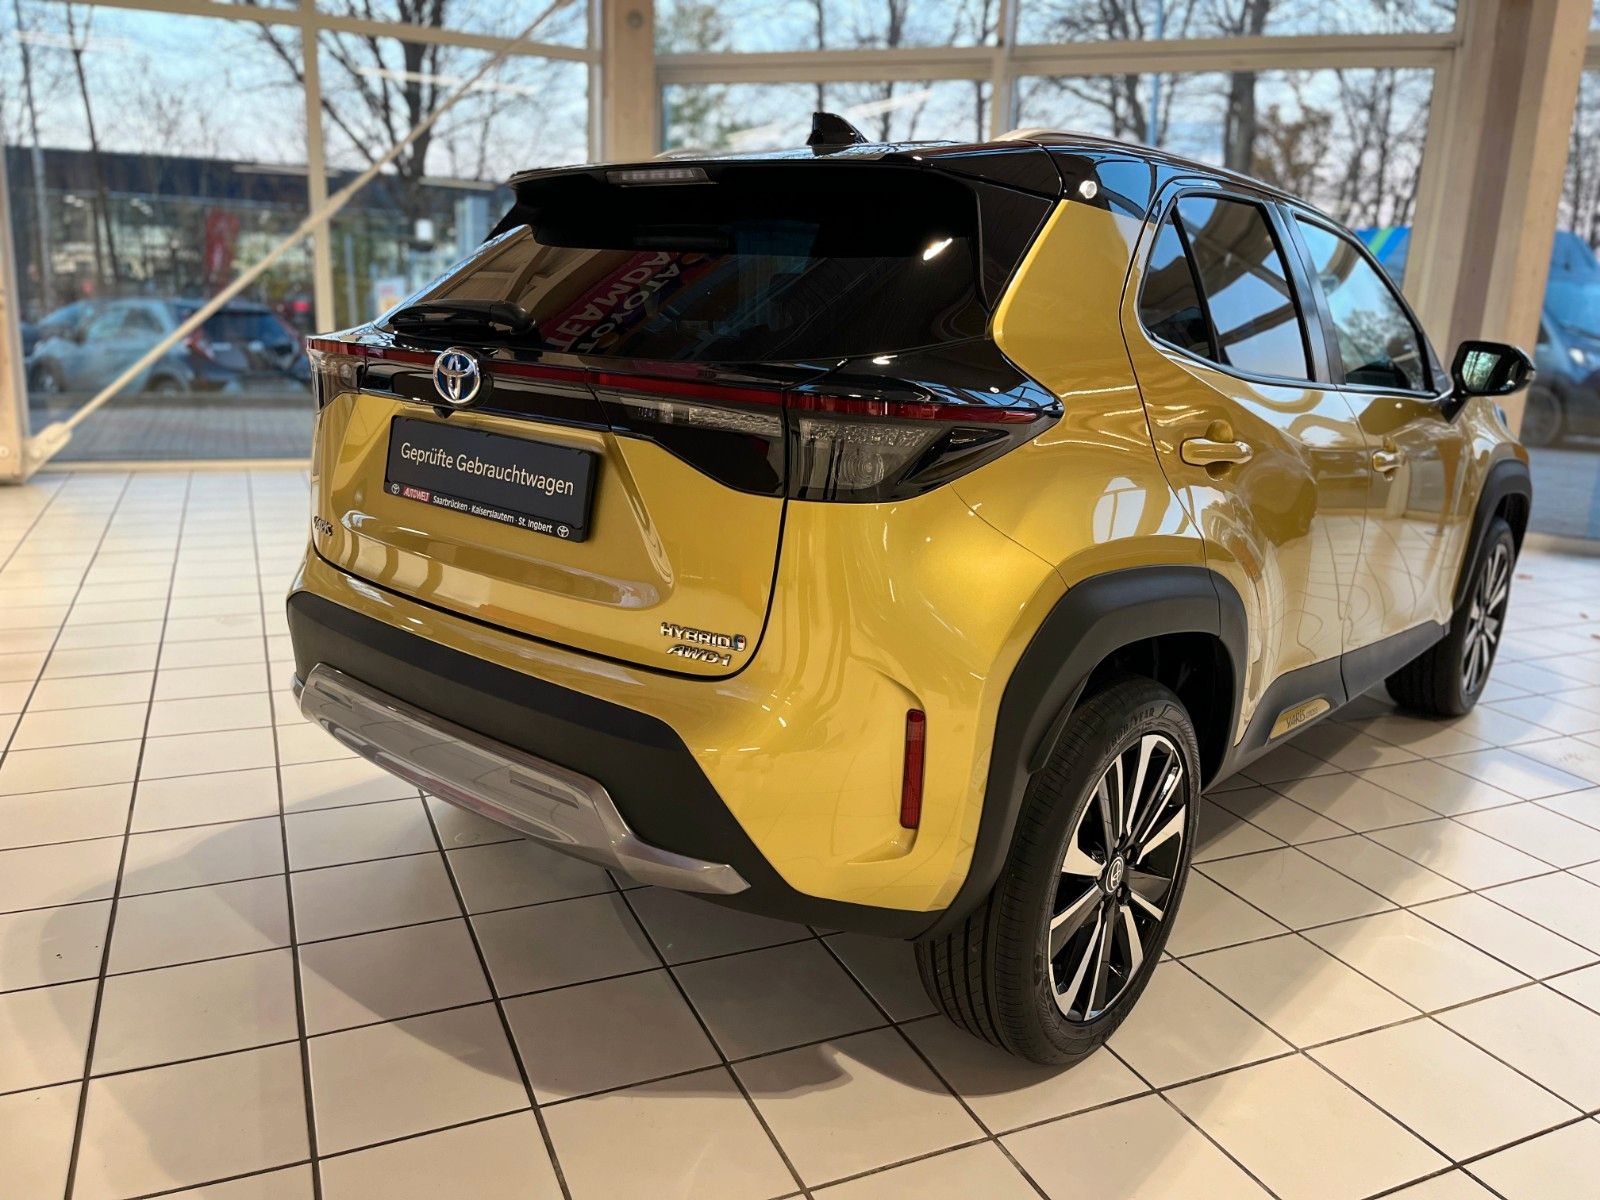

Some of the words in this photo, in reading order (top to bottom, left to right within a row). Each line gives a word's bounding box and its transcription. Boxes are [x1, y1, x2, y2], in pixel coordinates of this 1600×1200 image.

[401, 442, 453, 469] Geprüfte
[457, 454, 574, 496] Gebrauchtwagen
[403, 487, 431, 502] AUTOWELT
[433, 495, 468, 512] Saarbrücken
[471, 505, 514, 523] Kaiserslautern
[518, 517, 526, 527] St.
[528, 519, 553, 533] Ingbert
[660, 621, 734, 649] HYBRID
